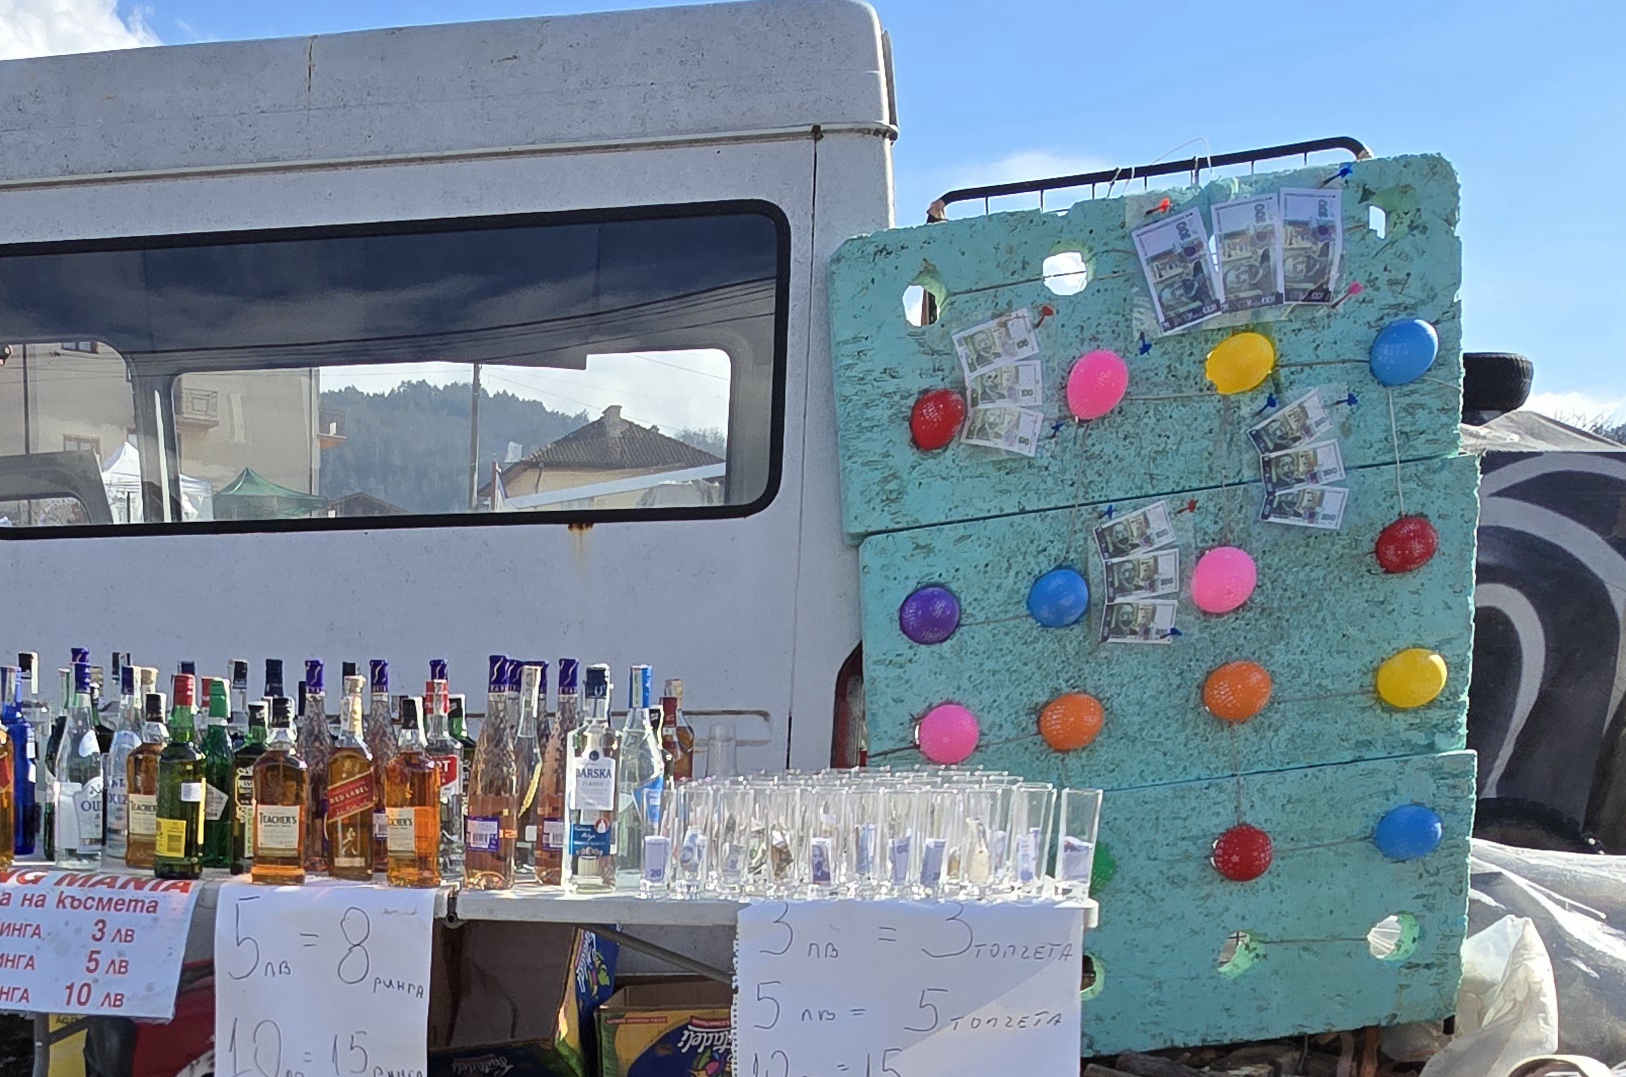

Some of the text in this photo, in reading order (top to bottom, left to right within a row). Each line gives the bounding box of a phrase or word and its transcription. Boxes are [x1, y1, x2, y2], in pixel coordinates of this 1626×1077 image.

[259, 812, 297, 825] TEACHER'S
[20, 894, 46, 909] на
[56, 891, 159, 915] късмета
[91, 919, 107, 943] 3
[110, 927, 135, 943] ЛВ
[85, 950, 102, 974] 5
[104, 958, 129, 976] ЛВ
[65, 982, 93, 1007] 10
[100, 991, 125, 1008] ЛВ
